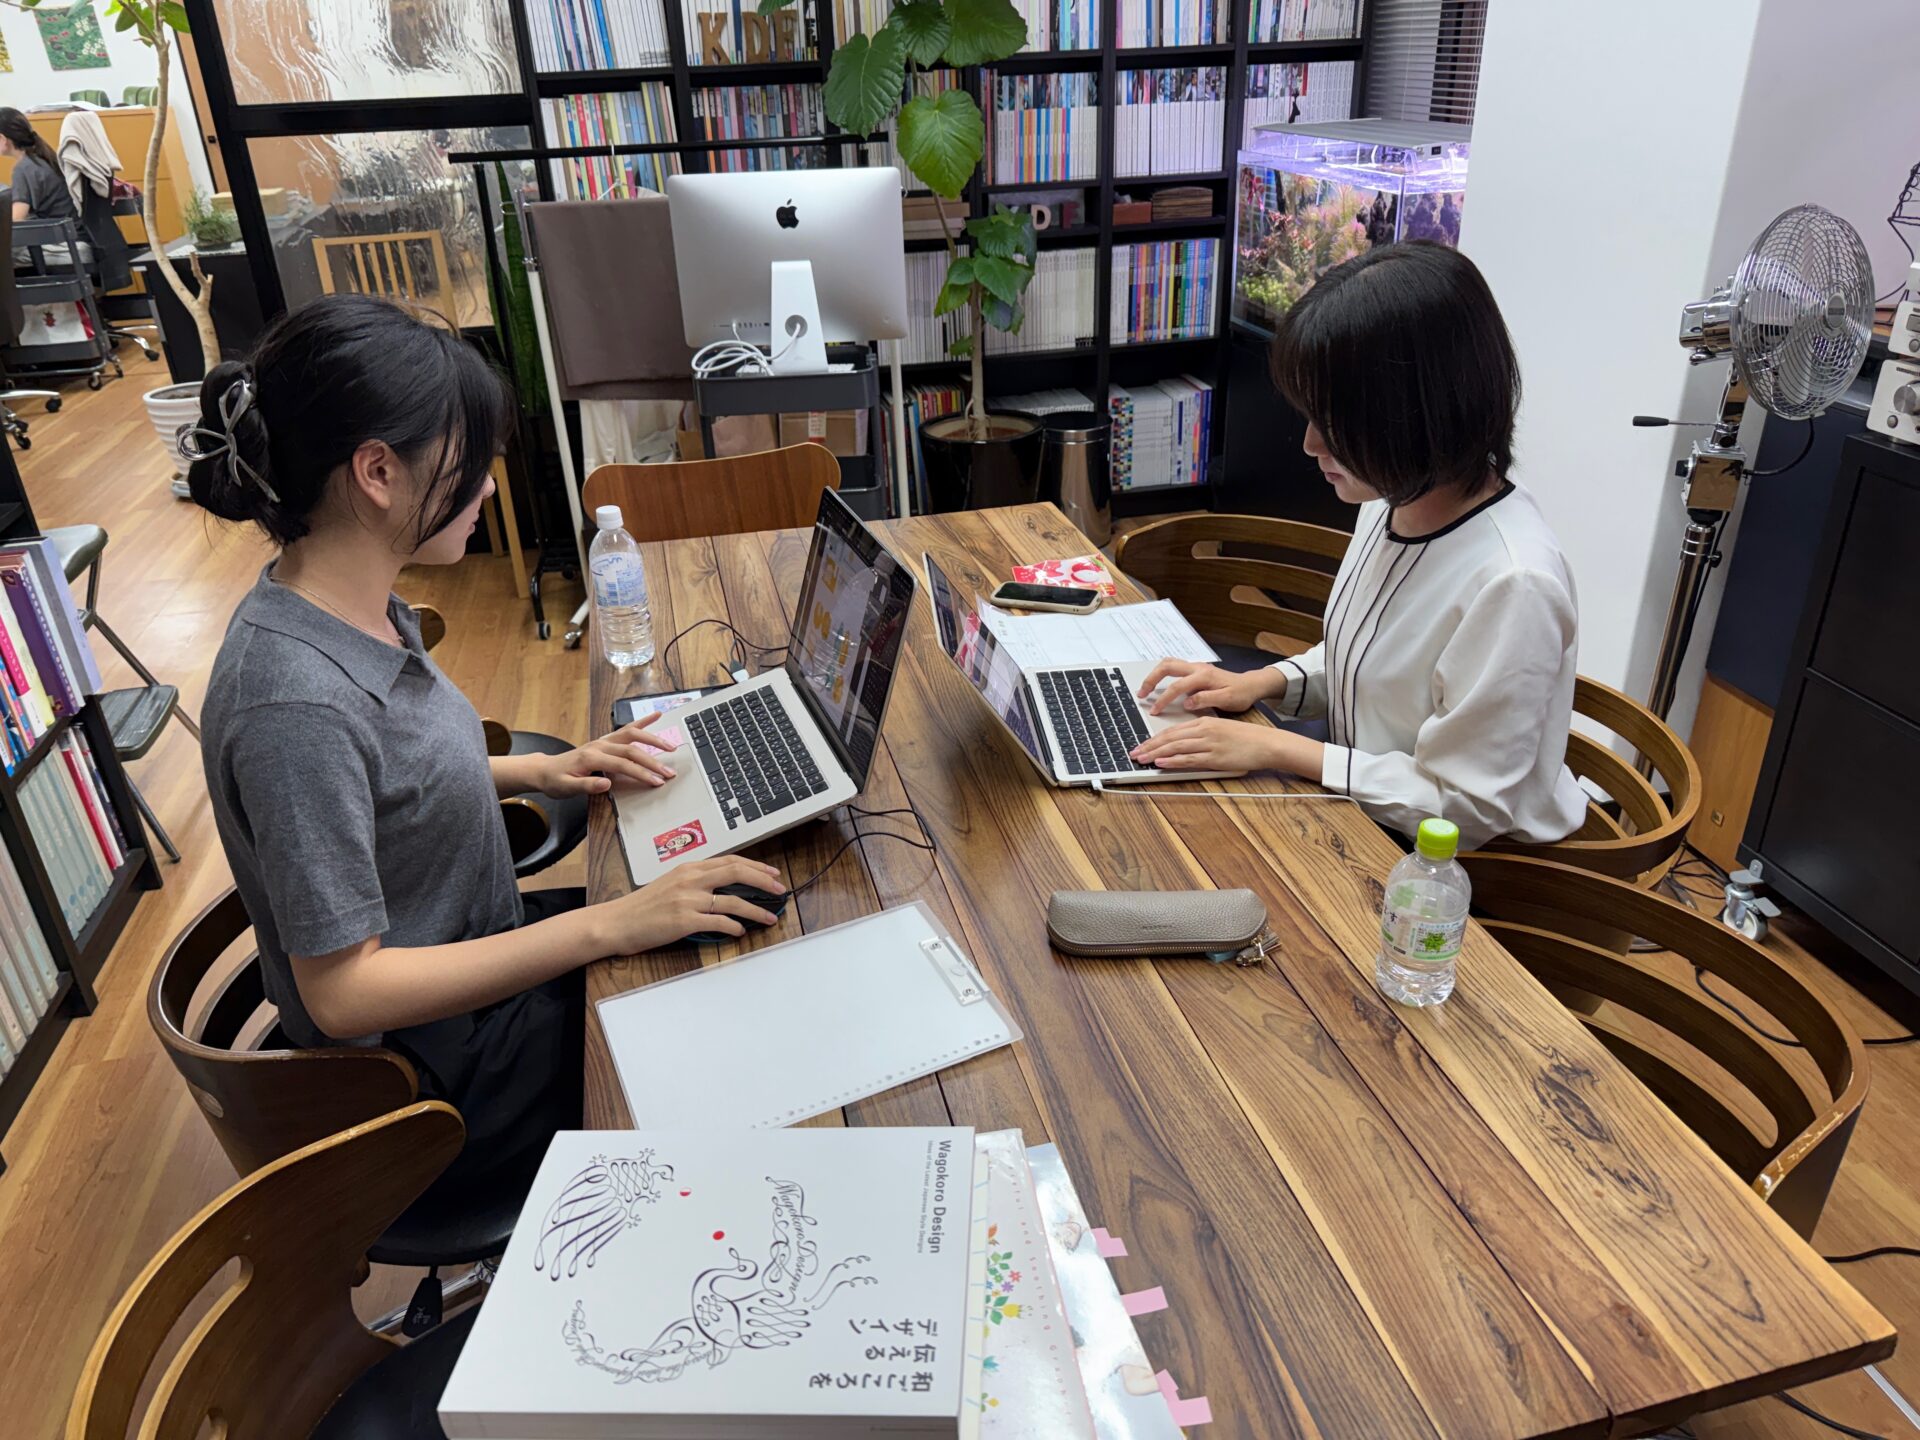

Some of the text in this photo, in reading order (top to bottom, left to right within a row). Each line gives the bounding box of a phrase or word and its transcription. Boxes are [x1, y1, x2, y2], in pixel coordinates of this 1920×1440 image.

[927, 1140, 952, 1254] Wagokoro Design
[788, 1240, 818, 1291] Design
[848, 1318, 938, 1336] デザイン
[865, 1343, 937, 1363] 伝える
[809, 1371, 934, 1392] 和ごころを
